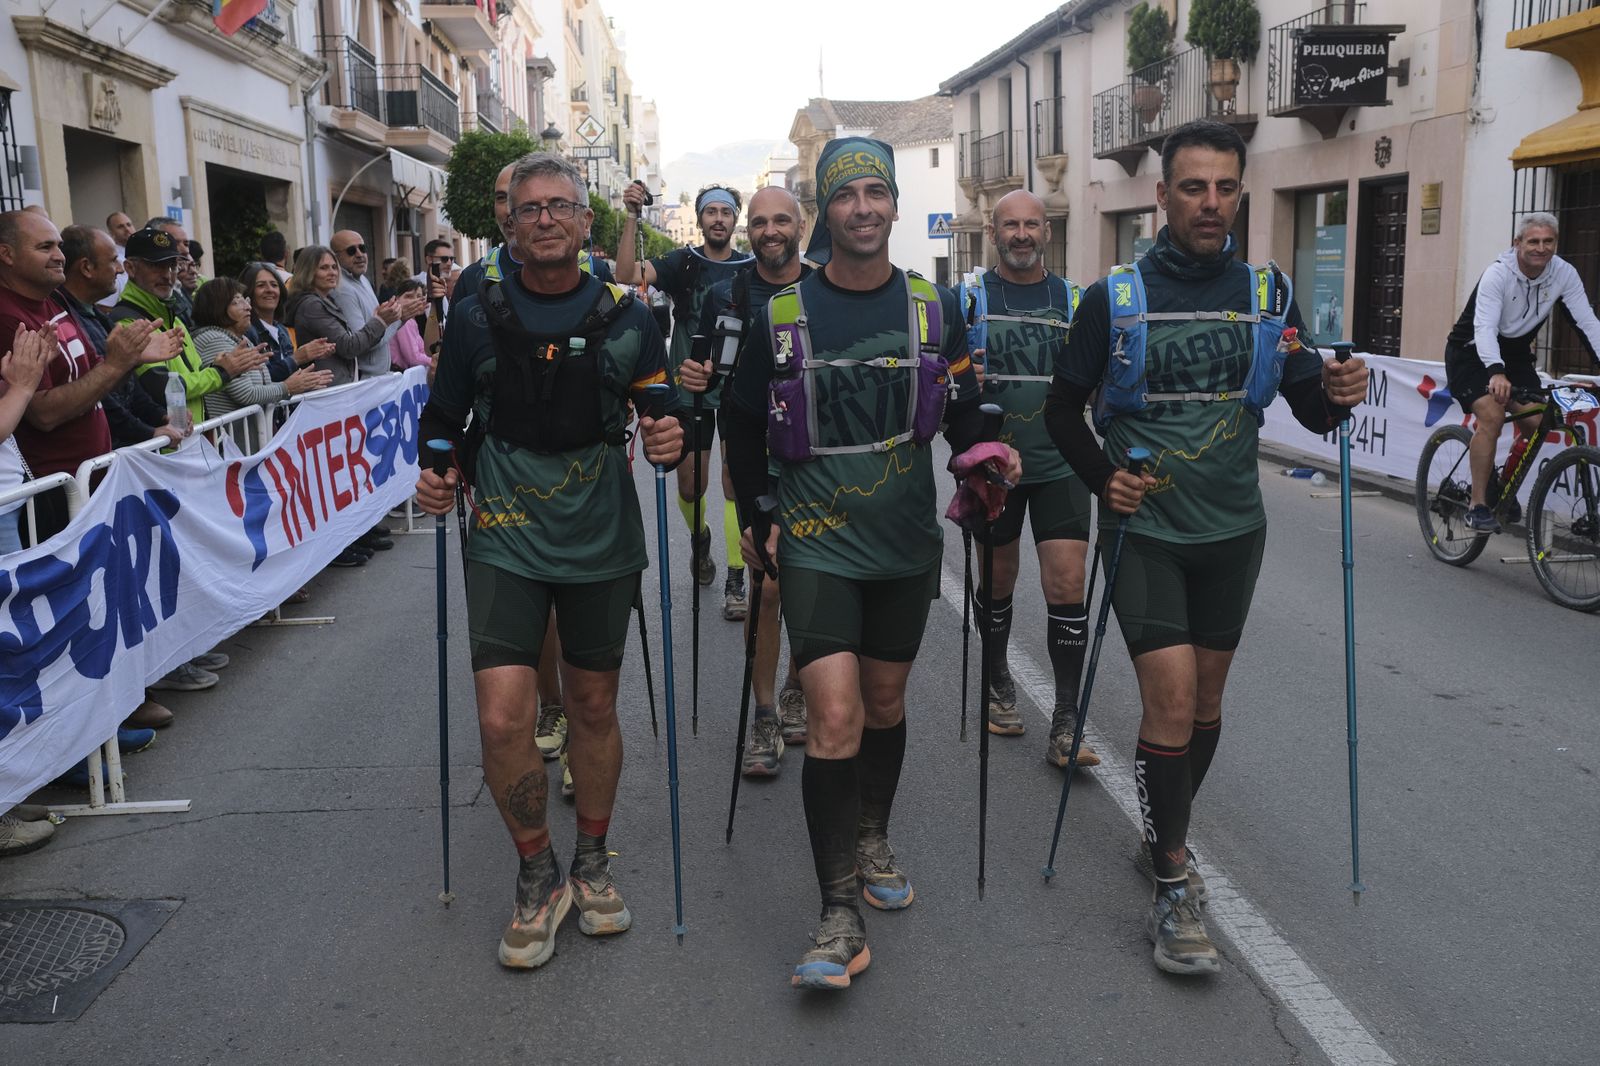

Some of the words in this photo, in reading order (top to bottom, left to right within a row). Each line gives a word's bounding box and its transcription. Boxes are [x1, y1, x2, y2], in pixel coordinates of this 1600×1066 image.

[1303, 44, 1386, 58] PELUQUERIA
[208, 128, 239, 154] HOTEL
[264, 383, 431, 548] INTERSPO
[1135, 760, 1158, 844] WONG
